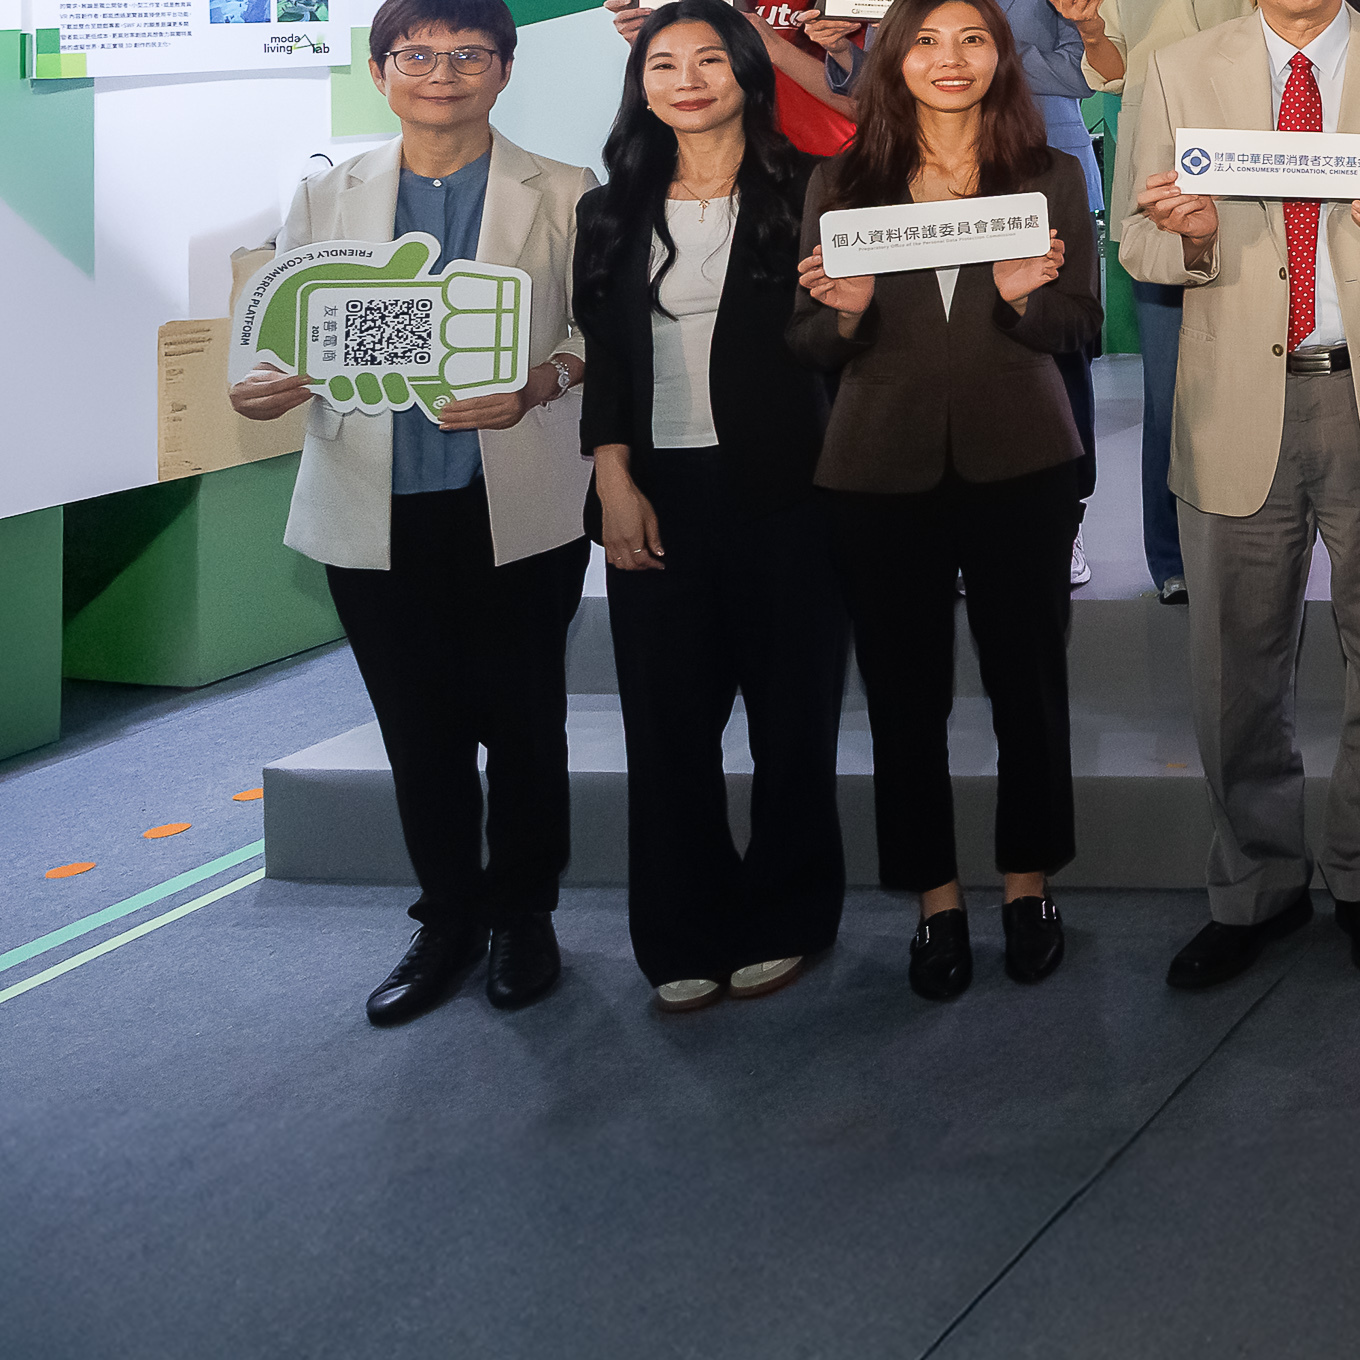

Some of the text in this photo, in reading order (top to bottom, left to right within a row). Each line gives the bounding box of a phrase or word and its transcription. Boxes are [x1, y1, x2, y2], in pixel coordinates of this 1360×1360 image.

[270, 34, 301, 44] moda
[263, 42, 293, 55] living
[1214, 151, 1236, 163] 財團
[1213, 162, 1236, 173] 法人
[1282, 167, 1328, 176] FOUNDATION,
[831, 214, 1040, 249] 個人資料保護委員會籌備處
[239, 247, 373, 347] FRIENDLY E-COMMERCE PLATFORM
[311, 325, 320, 343] 2025
[322, 305, 339, 363] 友善電商
